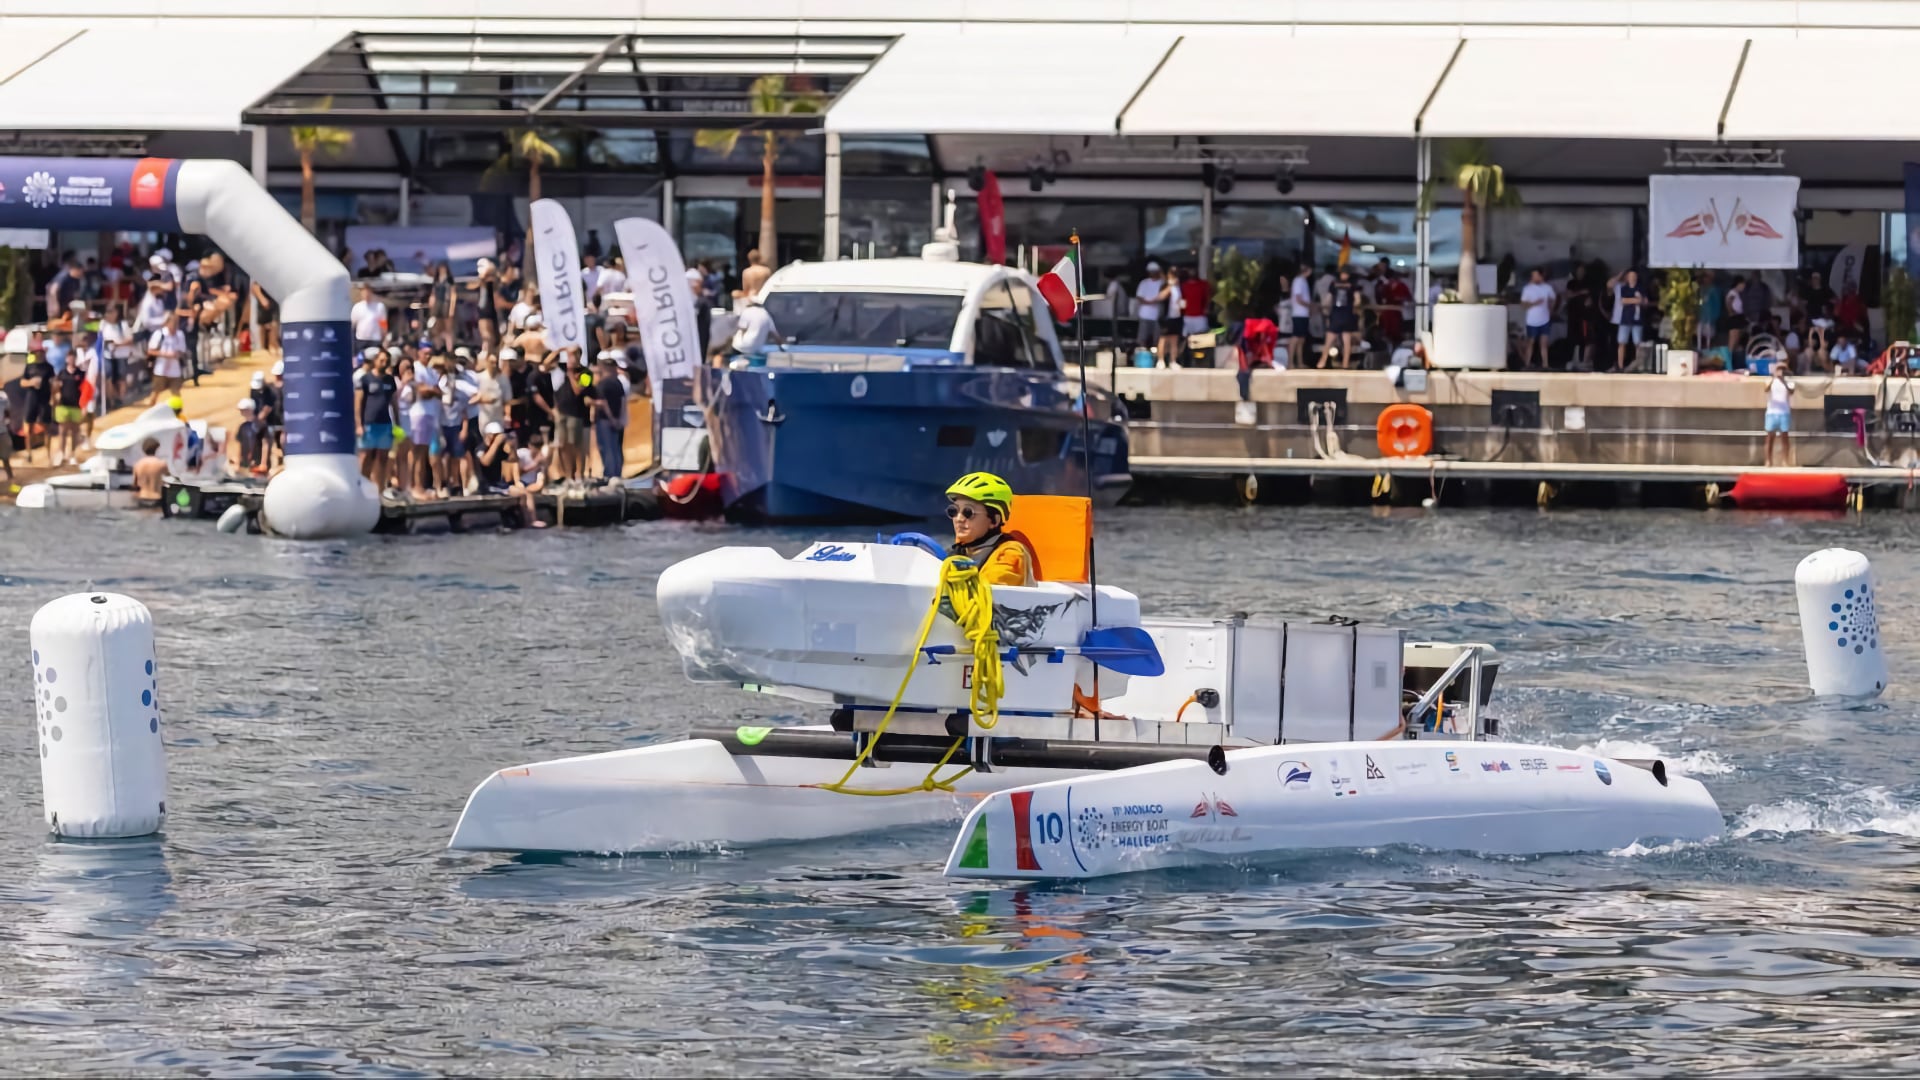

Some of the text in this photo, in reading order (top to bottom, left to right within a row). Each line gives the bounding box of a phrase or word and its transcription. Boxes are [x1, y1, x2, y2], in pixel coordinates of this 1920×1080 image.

[1124, 804, 1164, 816] MONACO
[1036, 812, 1064, 845] 10
[1111, 819, 1169, 834] ENERGY BOAT
